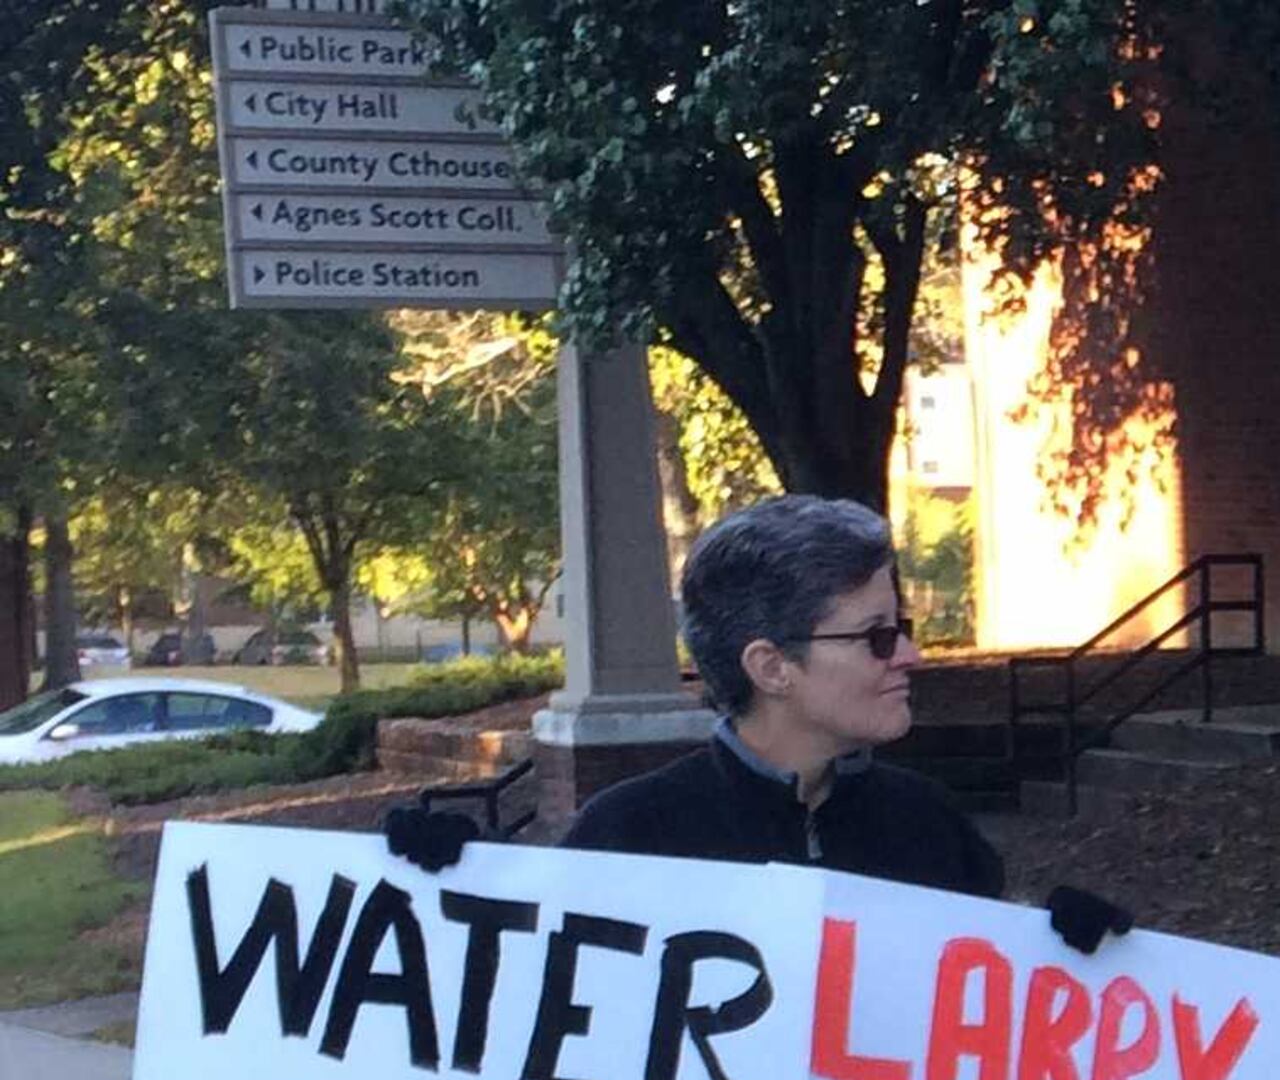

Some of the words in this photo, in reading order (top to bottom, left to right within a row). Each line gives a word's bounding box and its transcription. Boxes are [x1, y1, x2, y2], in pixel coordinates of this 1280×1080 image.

[260, 36, 353, 65] Public
[264, 92, 326, 124] City
[338, 94, 398, 120] Hall
[268, 149, 379, 181] County
[389, 151, 510, 179] Cthouse
[272, 202, 361, 232] Agnes
[370, 203, 449, 230] Scott
[457, 206, 523, 232] Coll.
[275, 262, 364, 287] Police
[374, 264, 480, 288] Station
